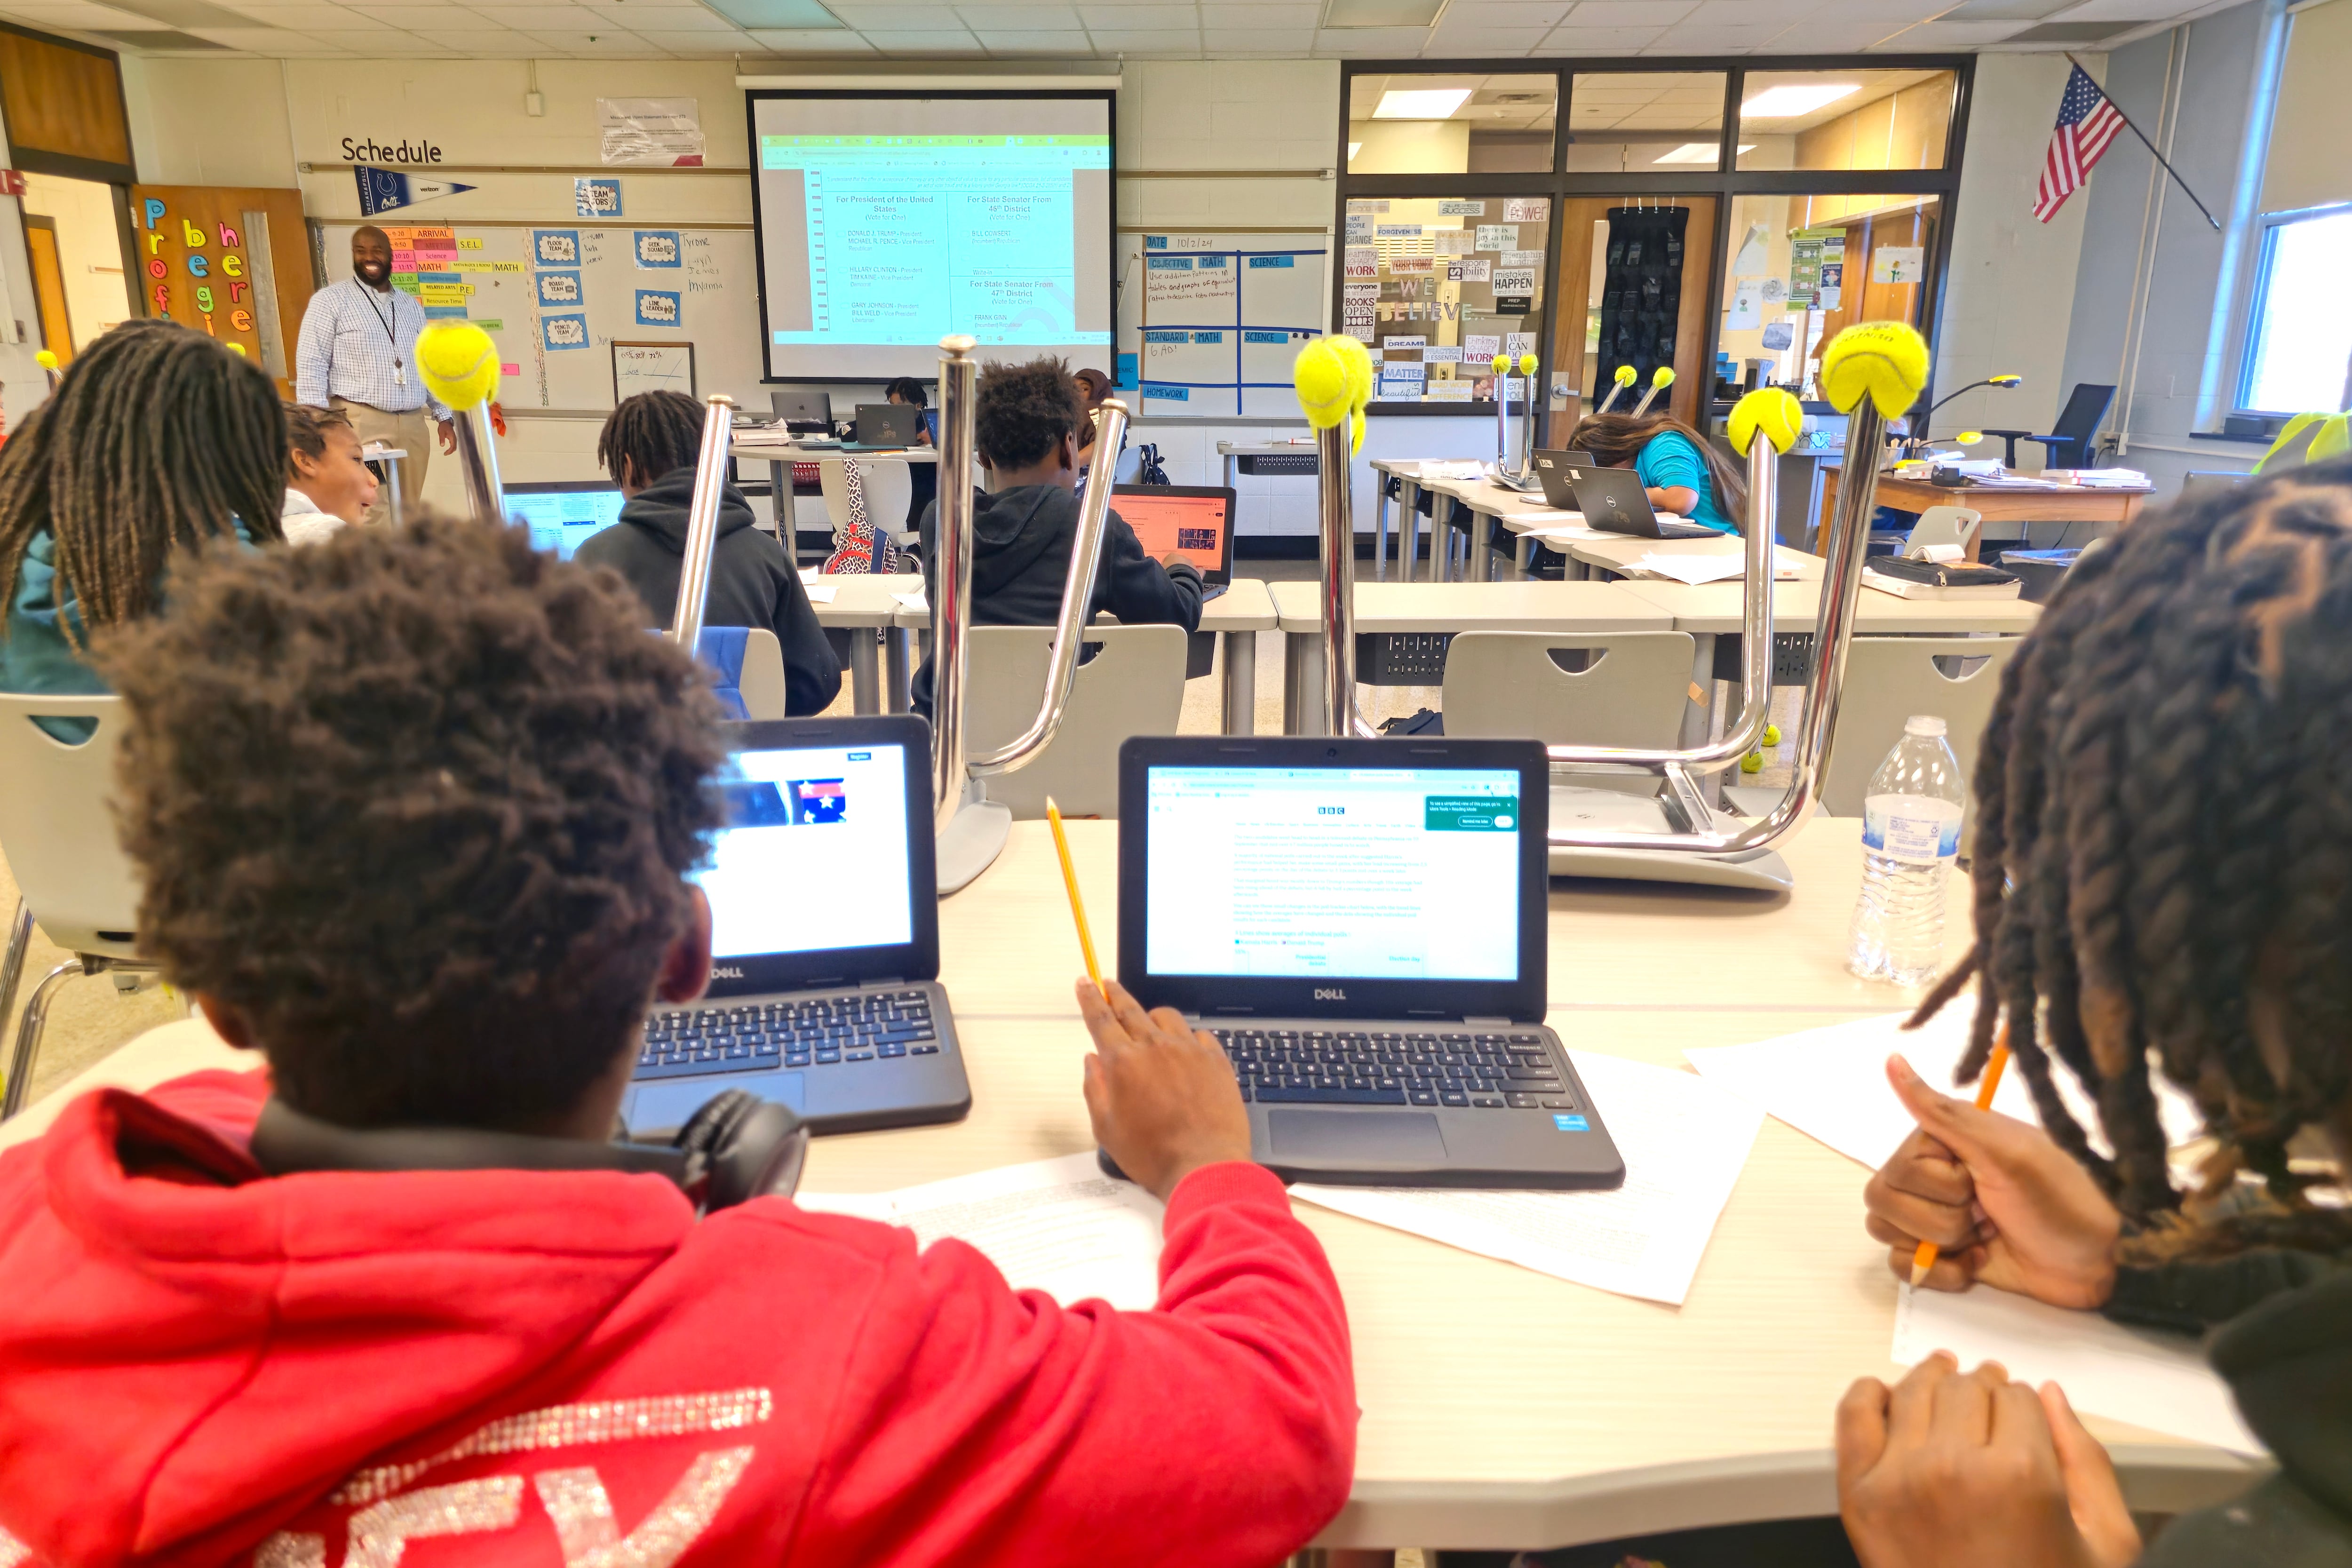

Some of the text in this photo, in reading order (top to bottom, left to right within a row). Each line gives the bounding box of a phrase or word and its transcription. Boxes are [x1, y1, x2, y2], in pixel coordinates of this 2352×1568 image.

[342, 137, 442, 164] Schedule
[360, 168, 372, 215] INDIANAPOLIS
[381, 196, 402, 210] Colts
[417, 230, 449, 238] ARRIVAL
[460, 240, 480, 249] S.E.L.
[680, 233, 710, 249] Tyrone
[1147, 237, 1213, 248] DATE 10/2/24
[1346, 235, 1372, 245] CHANGE
[145, 198, 170, 320] Prof
[1346, 250, 1377, 260] learning
[1502, 251, 1543, 260] friendship
[1152, 260, 1189, 268] OBJECTIVE
[1202, 257, 1223, 267] MATH
[1249, 257, 1279, 267] SCIENCE
[495, 263, 518, 272] MATH
[1346, 266, 1375, 276] WORK
[1149, 271, 1162, 280] Use
[1495, 270, 1532, 279] mistakes
[1148, 282, 1167, 292] tables
[1400, 277, 1434, 297] WE
[1494, 278, 1532, 289] HAPPEN
[1346, 297, 1375, 307] BOOKS
[1345, 307, 1374, 316] OPEN
[1345, 317, 1373, 326] DOORS
[1145, 333, 1184, 342] STANDARD
[1198, 333, 1219, 342] MATH
[1245, 333, 1274, 342] SCIENCE
[1467, 336, 1497, 348] thinking
[1508, 342, 1528, 350] CAN
[1466, 353, 1495, 364] WORK
[1384, 368, 1423, 379] MATTER
[1146, 388, 1184, 398] HOMEWORK
[1381, 389, 1421, 401] beautiful
[1318, 806, 1345, 815] BBC
[710, 967, 745, 979] DELL
[1314, 988, 1346, 1001] DELL
